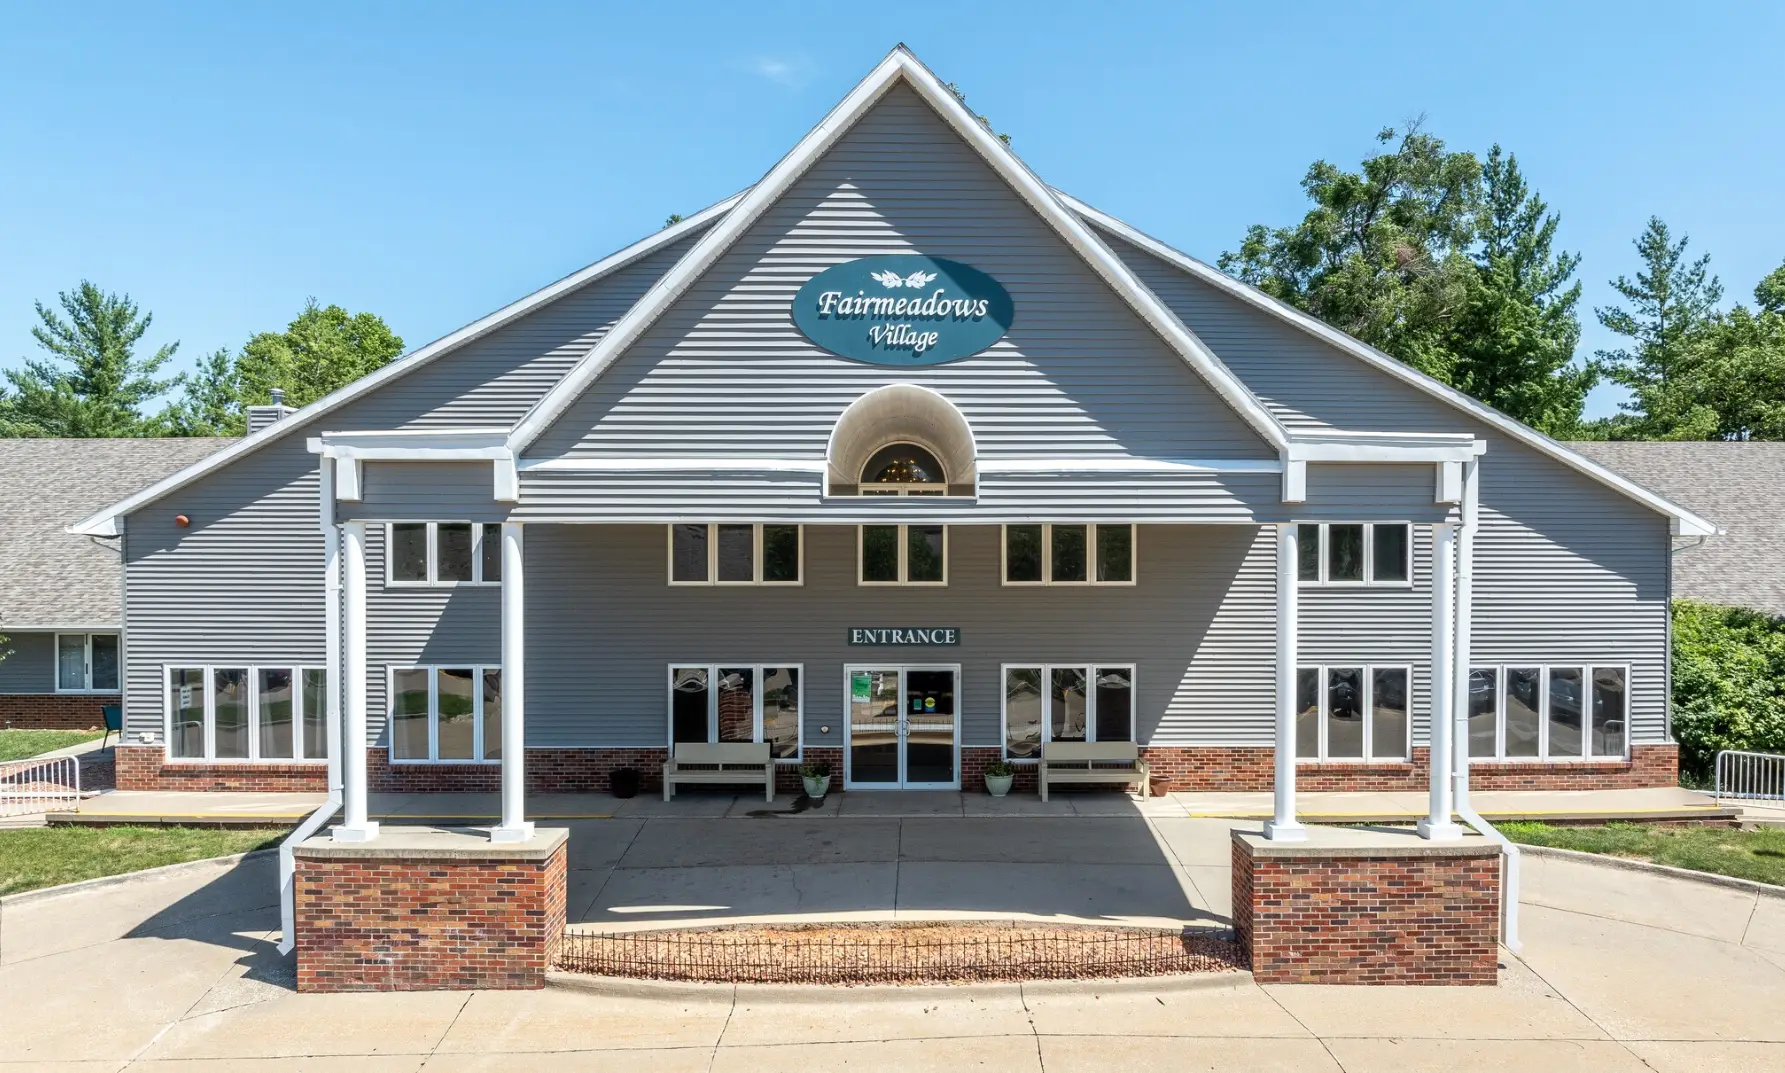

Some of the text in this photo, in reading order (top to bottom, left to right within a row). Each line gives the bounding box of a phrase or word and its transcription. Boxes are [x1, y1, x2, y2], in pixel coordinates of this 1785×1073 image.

[818, 288, 989, 317] Fairmeadows
[869, 323, 938, 352] Village
[851, 629, 956, 644] ENTRANCE
